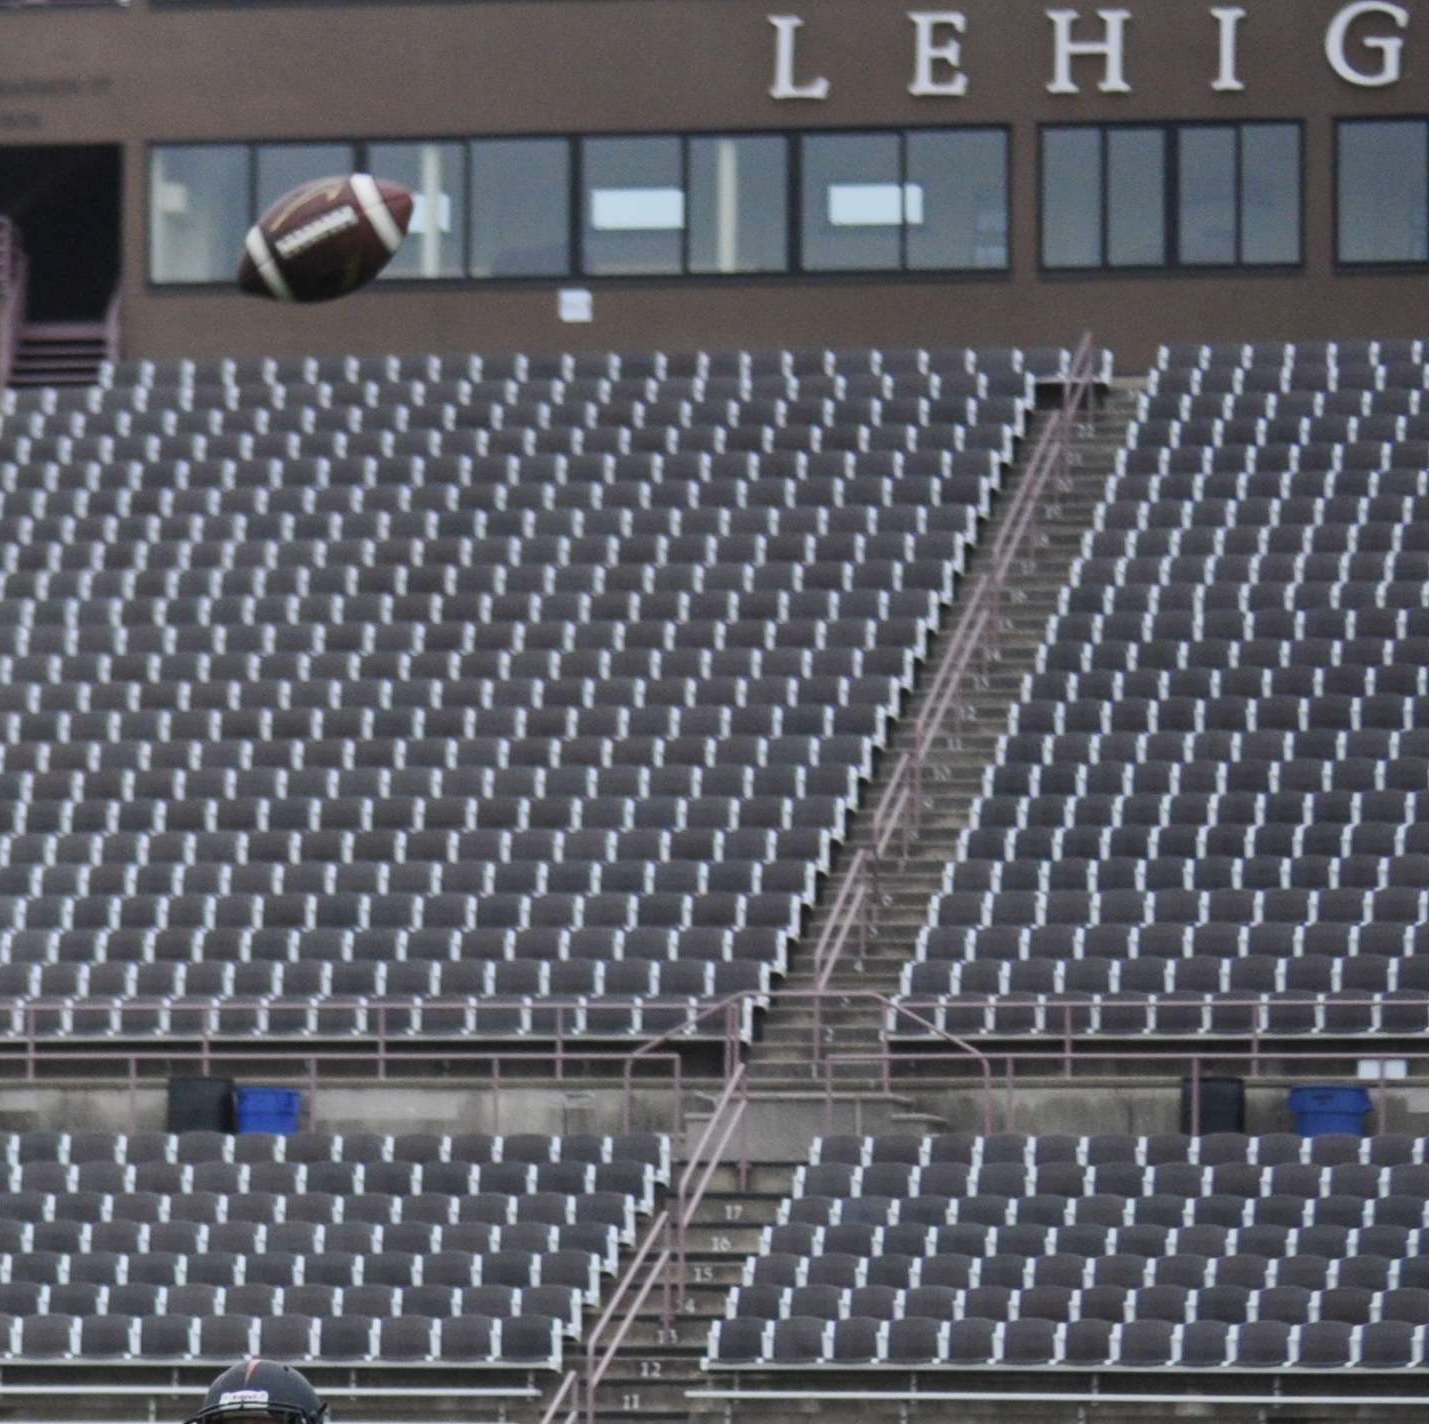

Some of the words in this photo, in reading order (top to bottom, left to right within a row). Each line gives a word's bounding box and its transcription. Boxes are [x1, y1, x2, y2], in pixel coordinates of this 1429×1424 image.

[725, 1205, 743, 1220] 17
[711, 1236, 731, 1252] 16
[693, 1267, 713, 1282] 15
[641, 1362, 662, 1378] 12
[622, 1394, 640, 1411] 11
